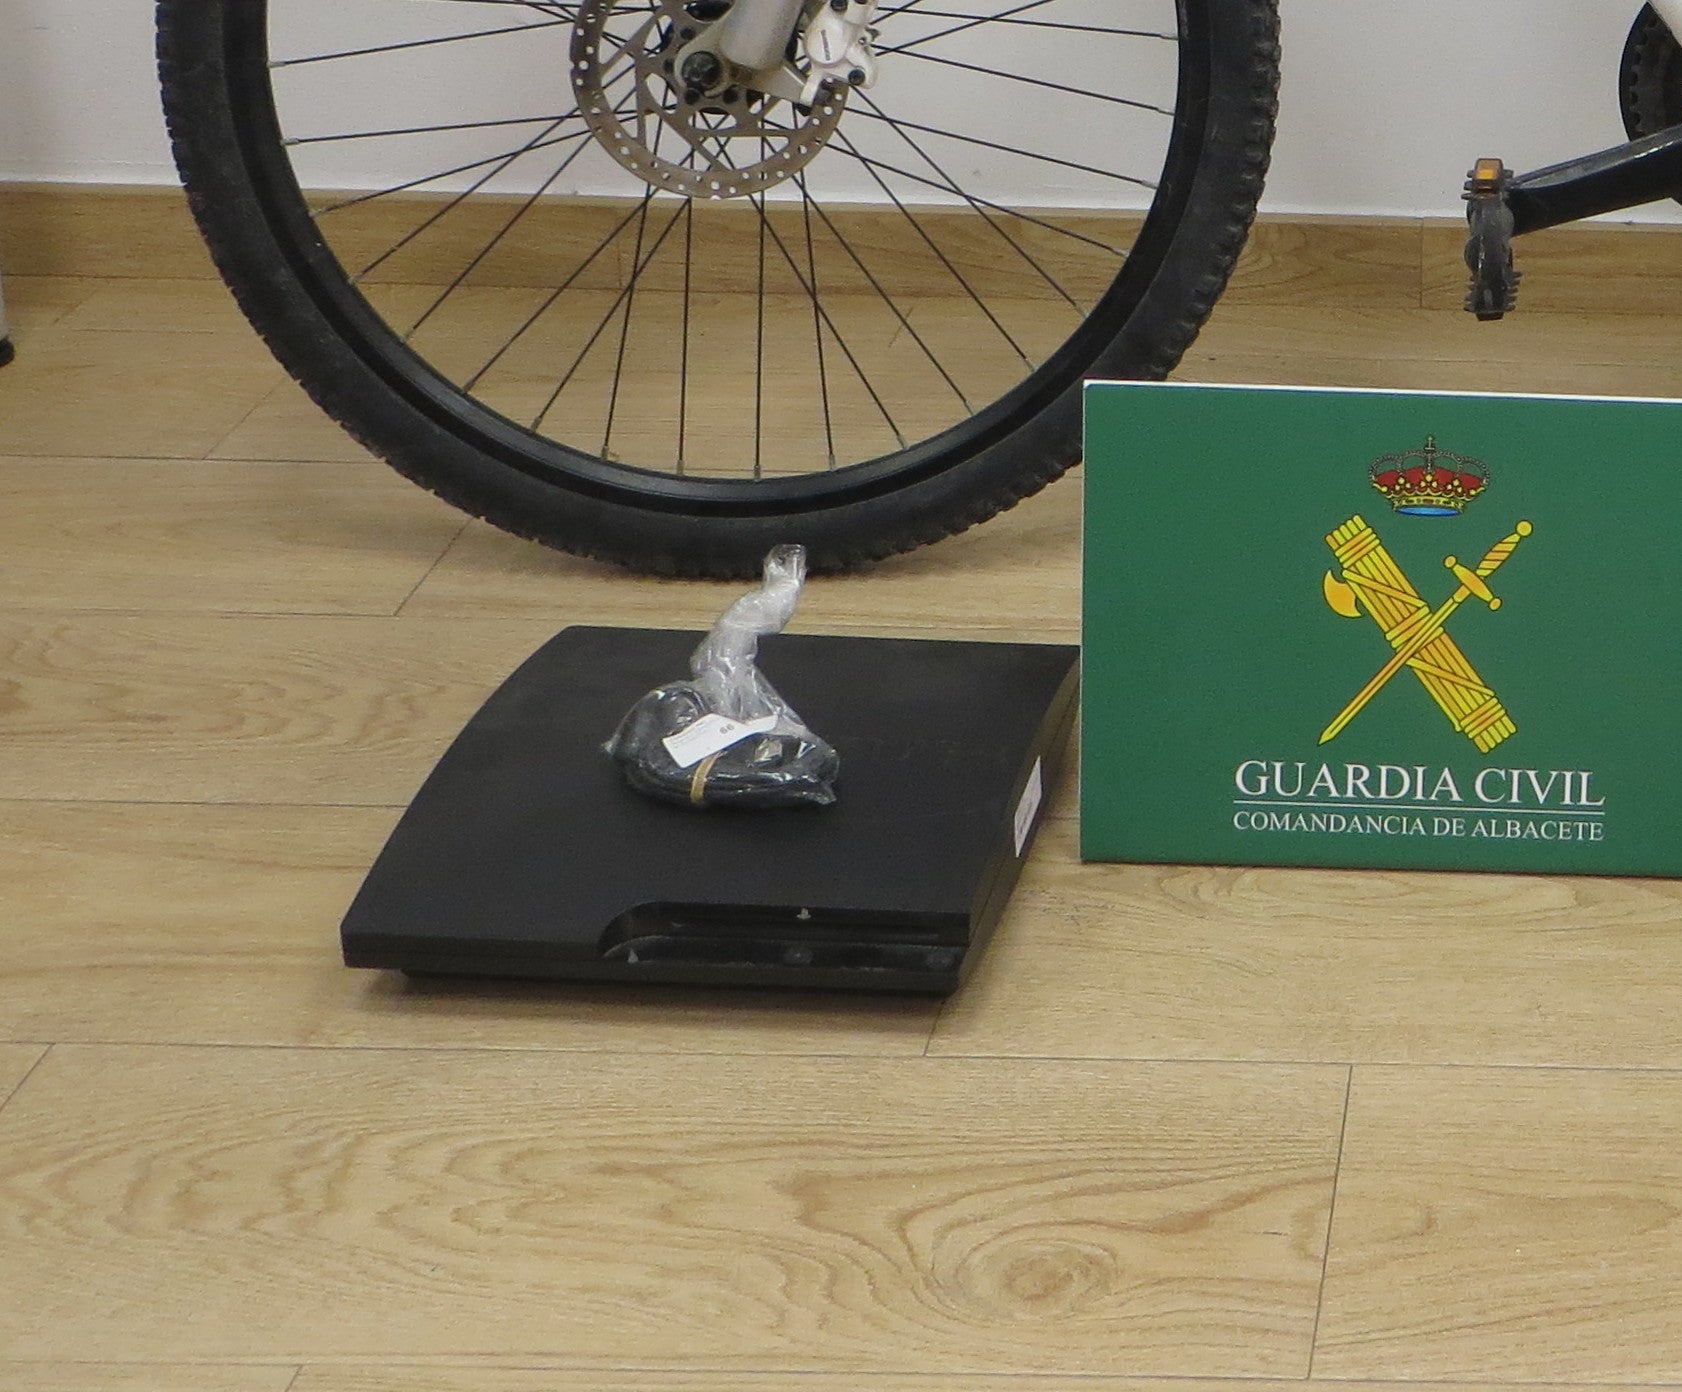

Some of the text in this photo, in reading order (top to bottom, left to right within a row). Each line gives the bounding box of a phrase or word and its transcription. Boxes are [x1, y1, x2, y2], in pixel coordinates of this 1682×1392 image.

[1233, 759, 1607, 806] GUARDIA CIVIL
[1232, 810, 1605, 842] COMANDANCIA DE ALBACETE
